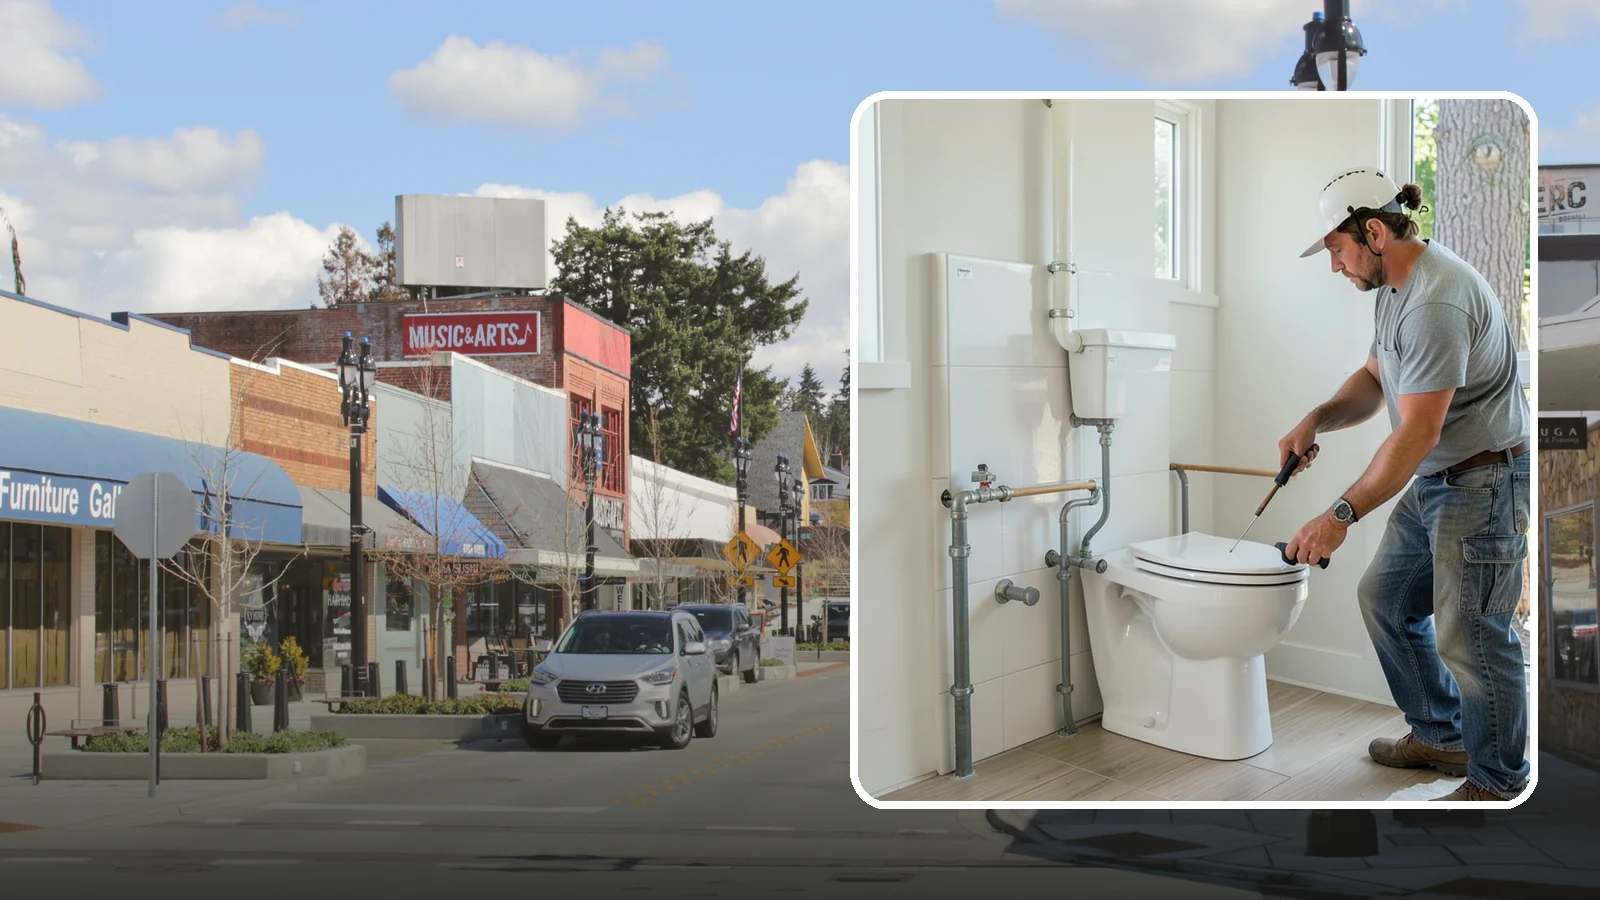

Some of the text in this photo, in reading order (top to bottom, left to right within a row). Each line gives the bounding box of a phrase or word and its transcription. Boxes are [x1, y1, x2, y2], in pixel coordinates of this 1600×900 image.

[409, 323, 519, 348] MUSIC&ARTS
[1540, 427, 1577, 436] UGA
[0, 472, 79, 515] Furniture
[453, 563, 479, 574] SUSHI
